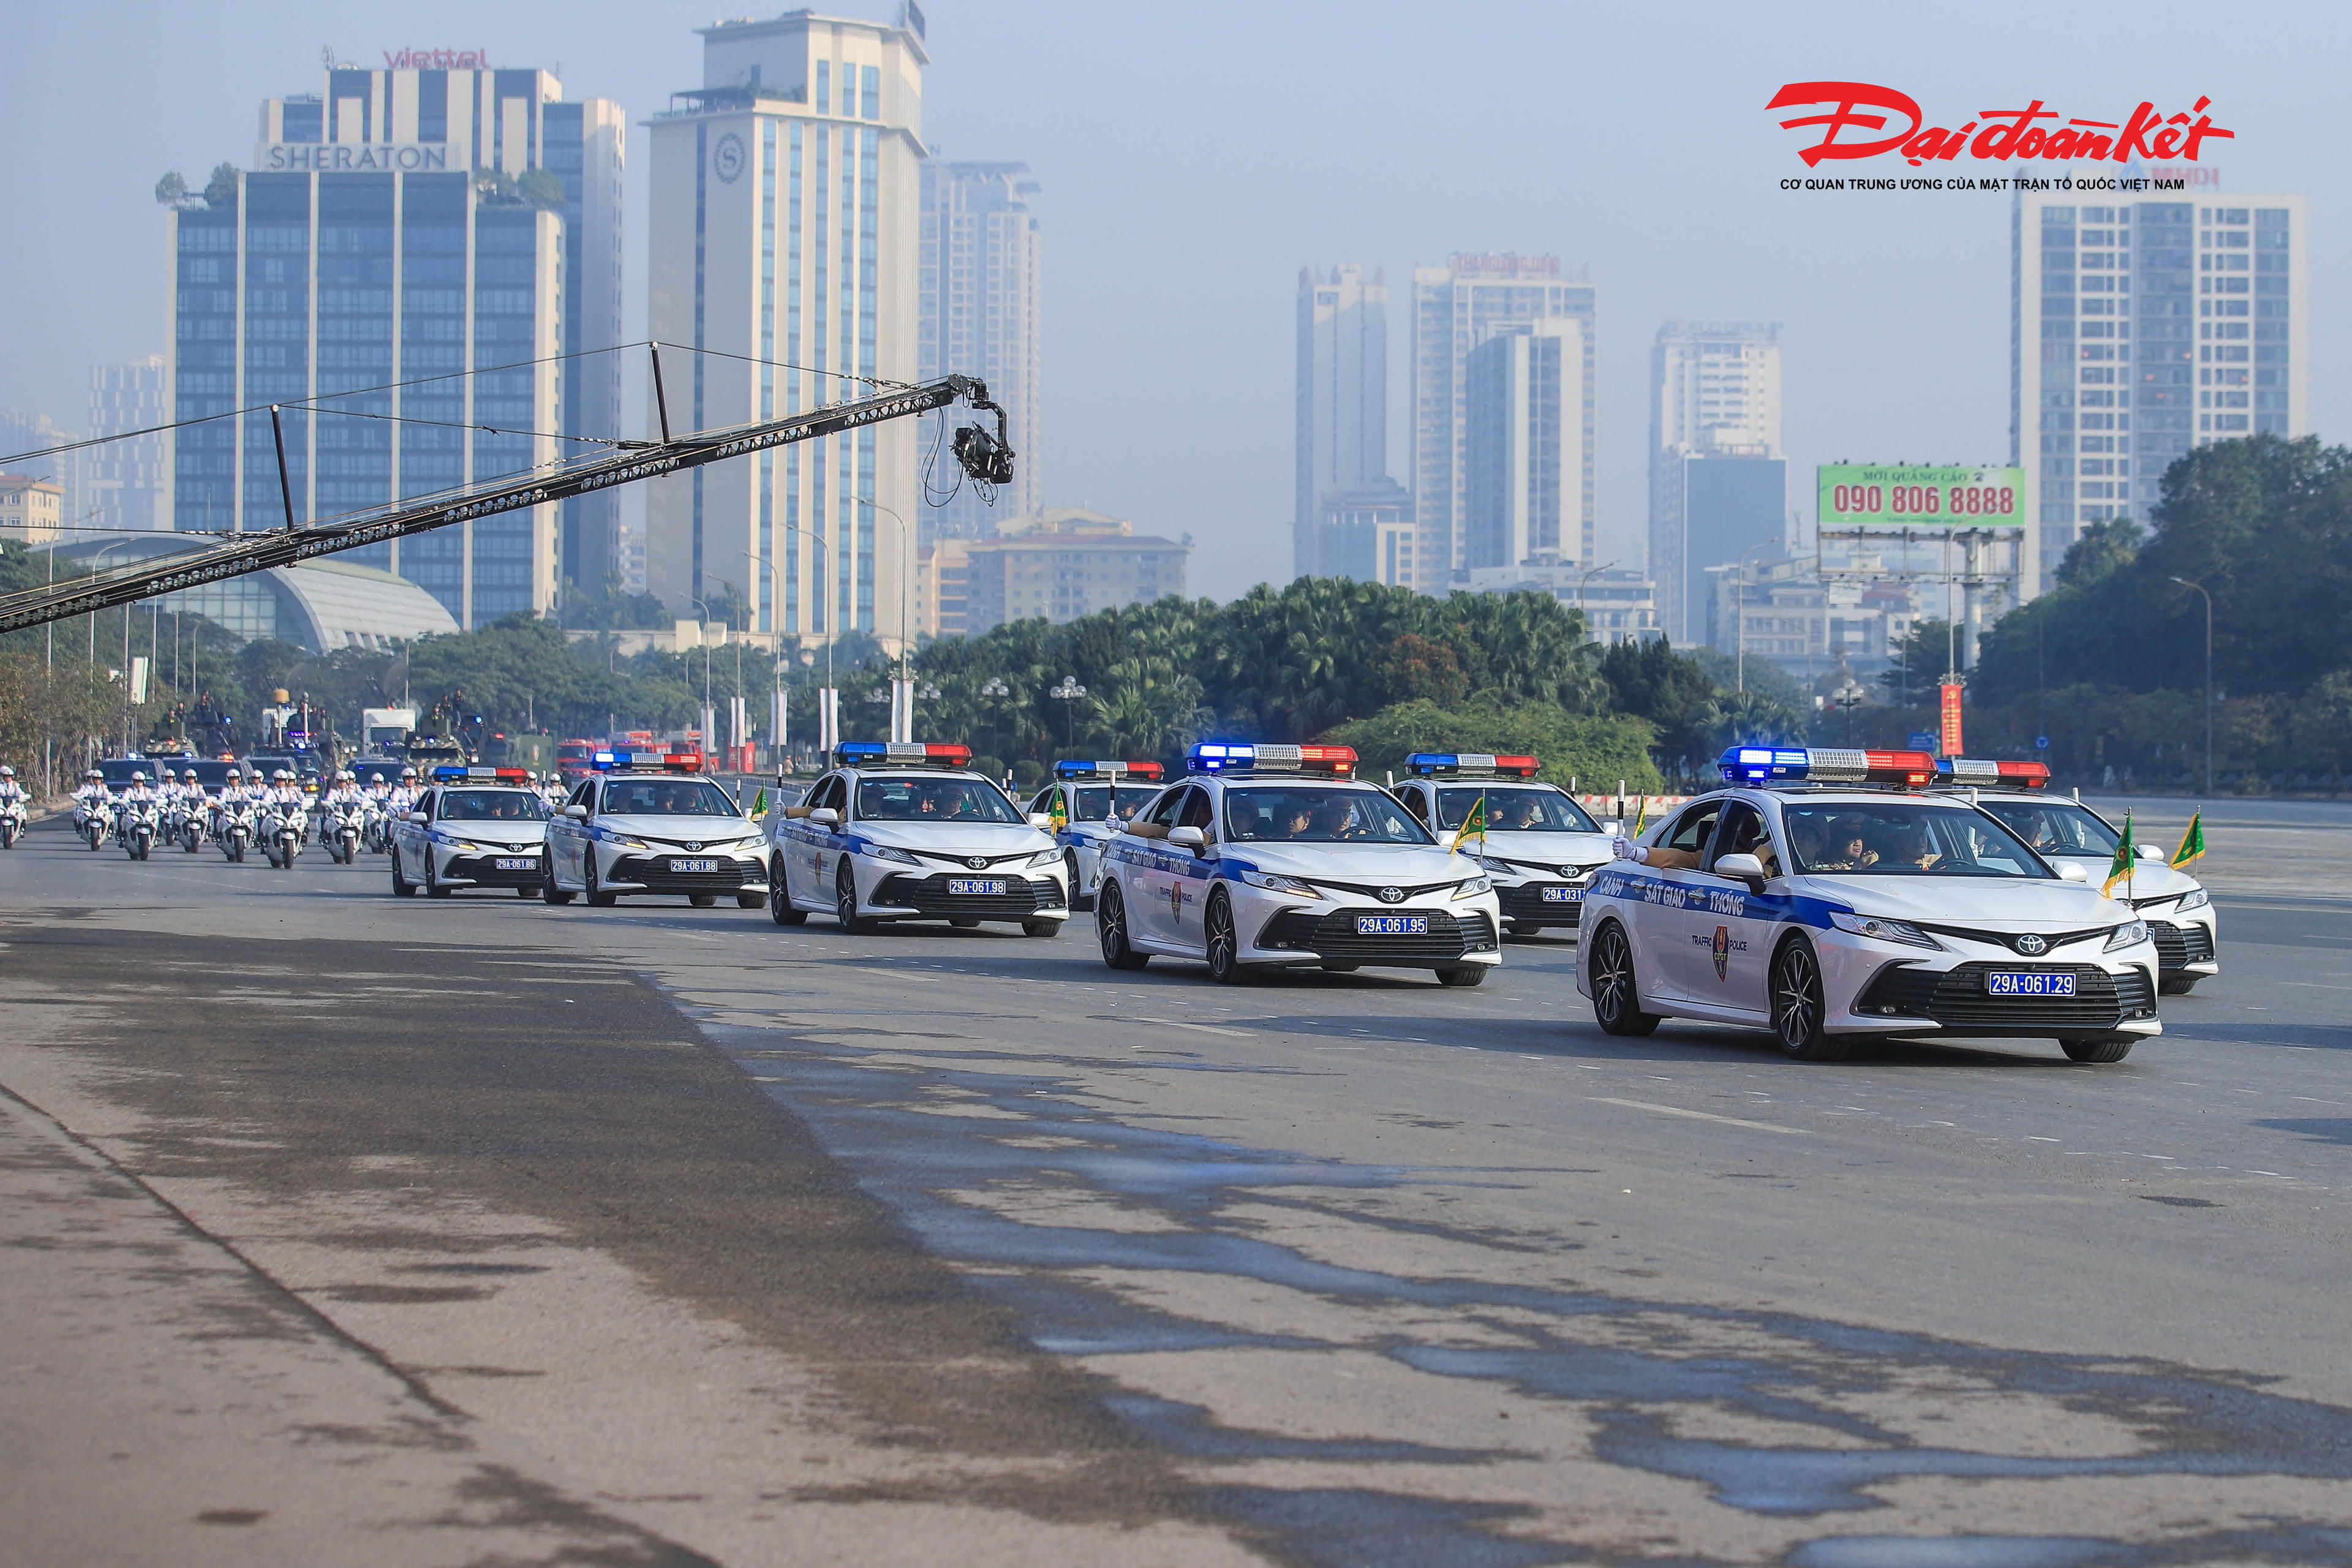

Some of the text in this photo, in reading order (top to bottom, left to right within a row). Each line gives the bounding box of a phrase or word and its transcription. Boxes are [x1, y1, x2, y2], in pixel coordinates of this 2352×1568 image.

[382, 47, 491, 69] viettel
[270, 146, 447, 170] SHERATON
[1834, 485, 2013, 515] 090 806 8888
[673, 861, 716, 870] 29A-061.88
[951, 881, 1004, 893] 29A-061.98
[1545, 889, 1585, 900] 29A-031.
[1644, 881, 1664, 903] SÁT
[1663, 886, 1686, 908] GIAO
[1709, 890, 1745, 916] THÔNG
[1360, 918, 1425, 932] 29A-061.95
[1692, 935, 1747, 952] TRAFFIC POLICE
[1714, 952, 1727, 961] CSGT
[1992, 974, 2073, 993] 29A-061.29
